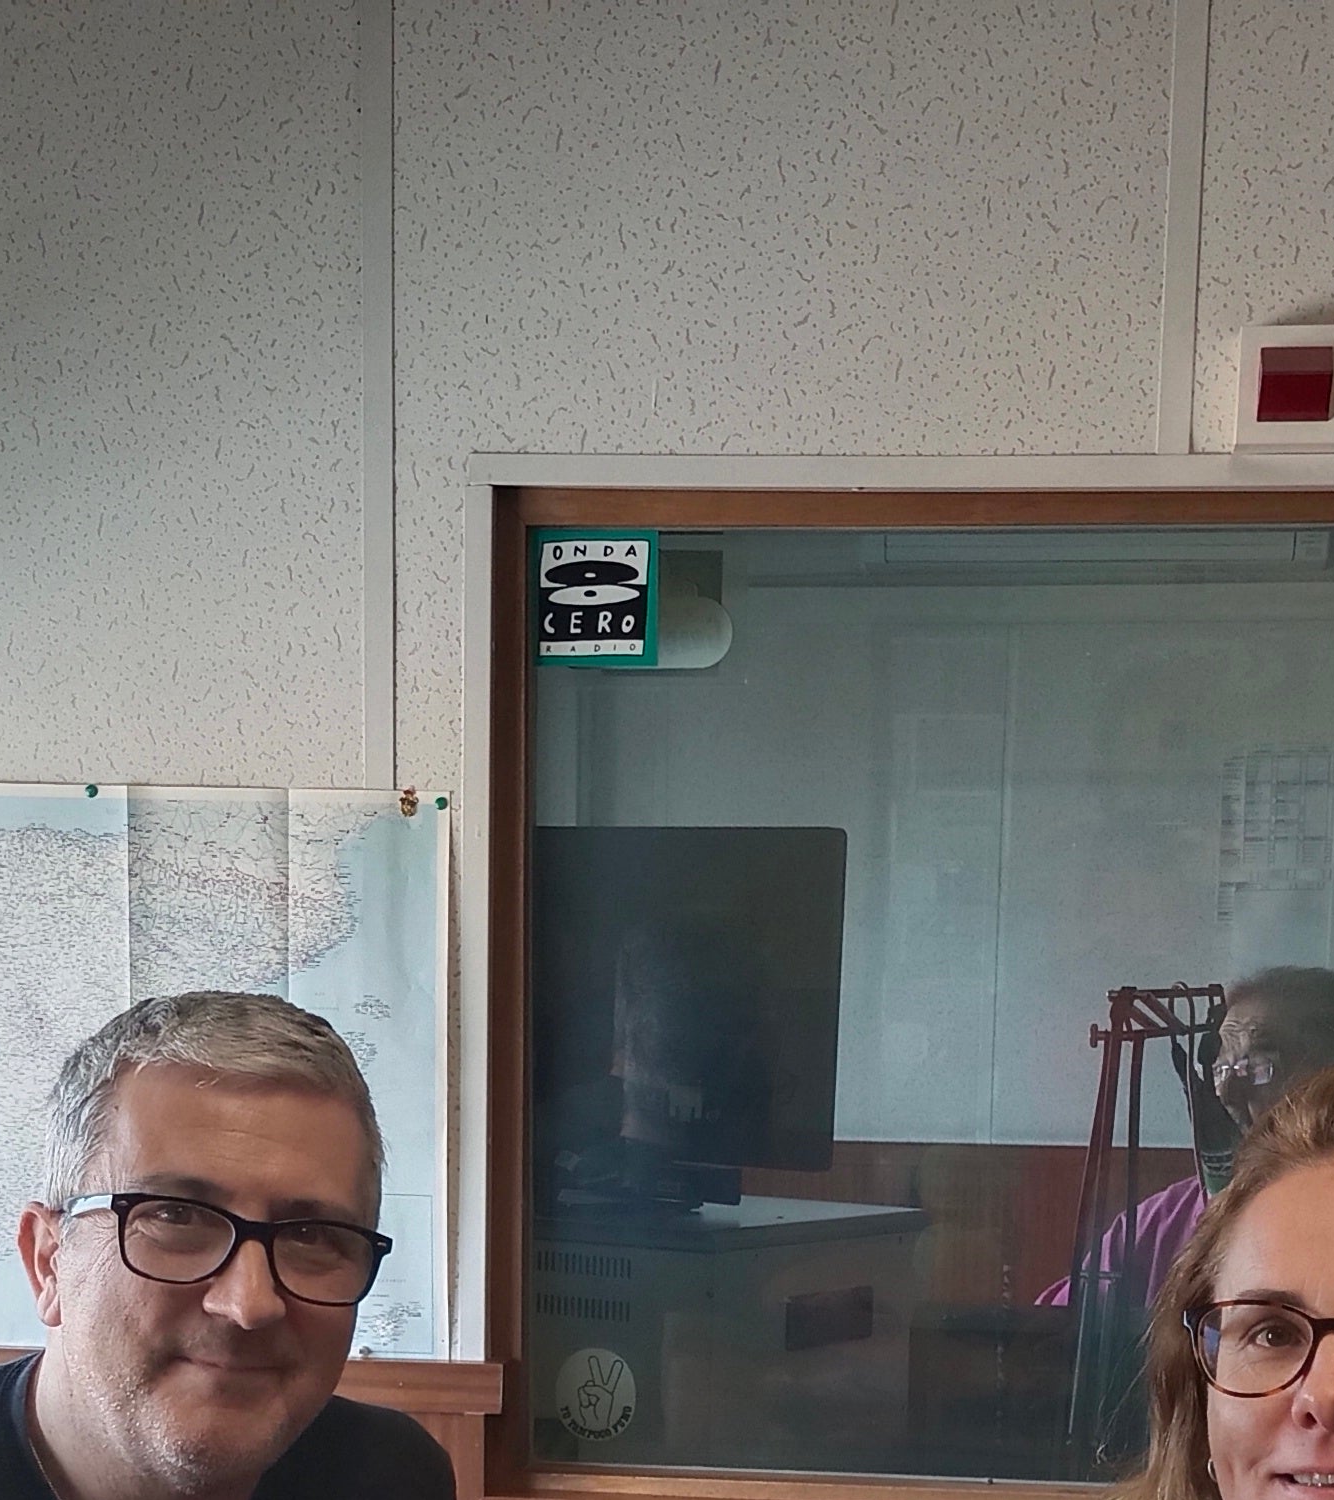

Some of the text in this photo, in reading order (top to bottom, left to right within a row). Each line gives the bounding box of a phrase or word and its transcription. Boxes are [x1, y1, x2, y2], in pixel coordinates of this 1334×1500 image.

[552, 545, 637, 560] ONDA
[543, 611, 635, 634] CERO
[545, 643, 636, 653] RADIO
[611, 1405, 633, 1433] FUMO
